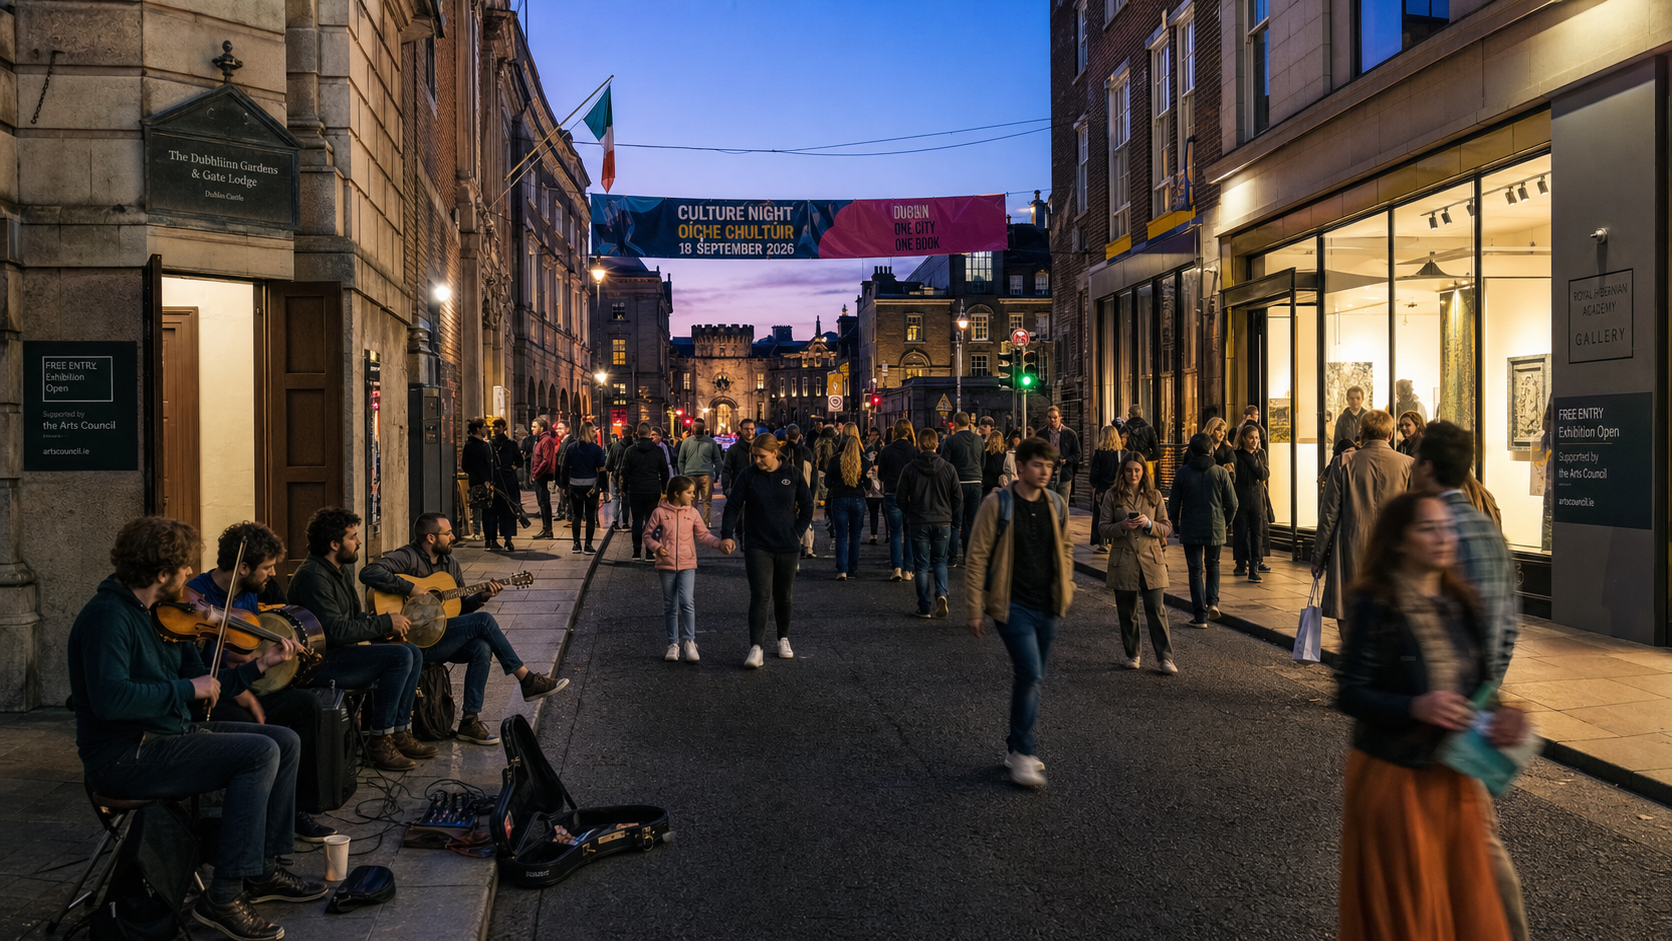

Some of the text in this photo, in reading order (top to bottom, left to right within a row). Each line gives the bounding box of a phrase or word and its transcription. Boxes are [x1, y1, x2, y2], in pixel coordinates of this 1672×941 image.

[168, 150, 188, 162] The
[240, 160, 279, 175] Gardens
[191, 169, 258, 189] & Gate Lodge
[677, 205, 794, 221] CULTURE NIGHT
[893, 204, 930, 220] DUBLIN
[677, 221, 795, 240] OÍCHE CHULTÚIR
[894, 221, 936, 236] ONE CITY
[678, 242, 795, 255] 18 SEPTEMBER 2026
[895, 236, 941, 252] ONE BOOK
[1582, 301, 1617, 317] ACADEMY
[1575, 327, 1626, 346] GALLERY
[45, 361, 98, 370] FREE ENTRY
[45, 372, 85, 381] Exhibition
[45, 384, 69, 394] Open
[76, 410, 86, 419] by
[1559, 407, 1604, 420] FREE ENTRY
[42, 420, 116, 430] the Arts Council
[1559, 425, 1620, 441] Exhibition Open
[42, 447, 90, 455] artscouncil.ie
[1559, 451, 1600, 464] Supported by
[1569, 468, 1582, 479] Arts
[1583, 468, 1608, 479] Council
